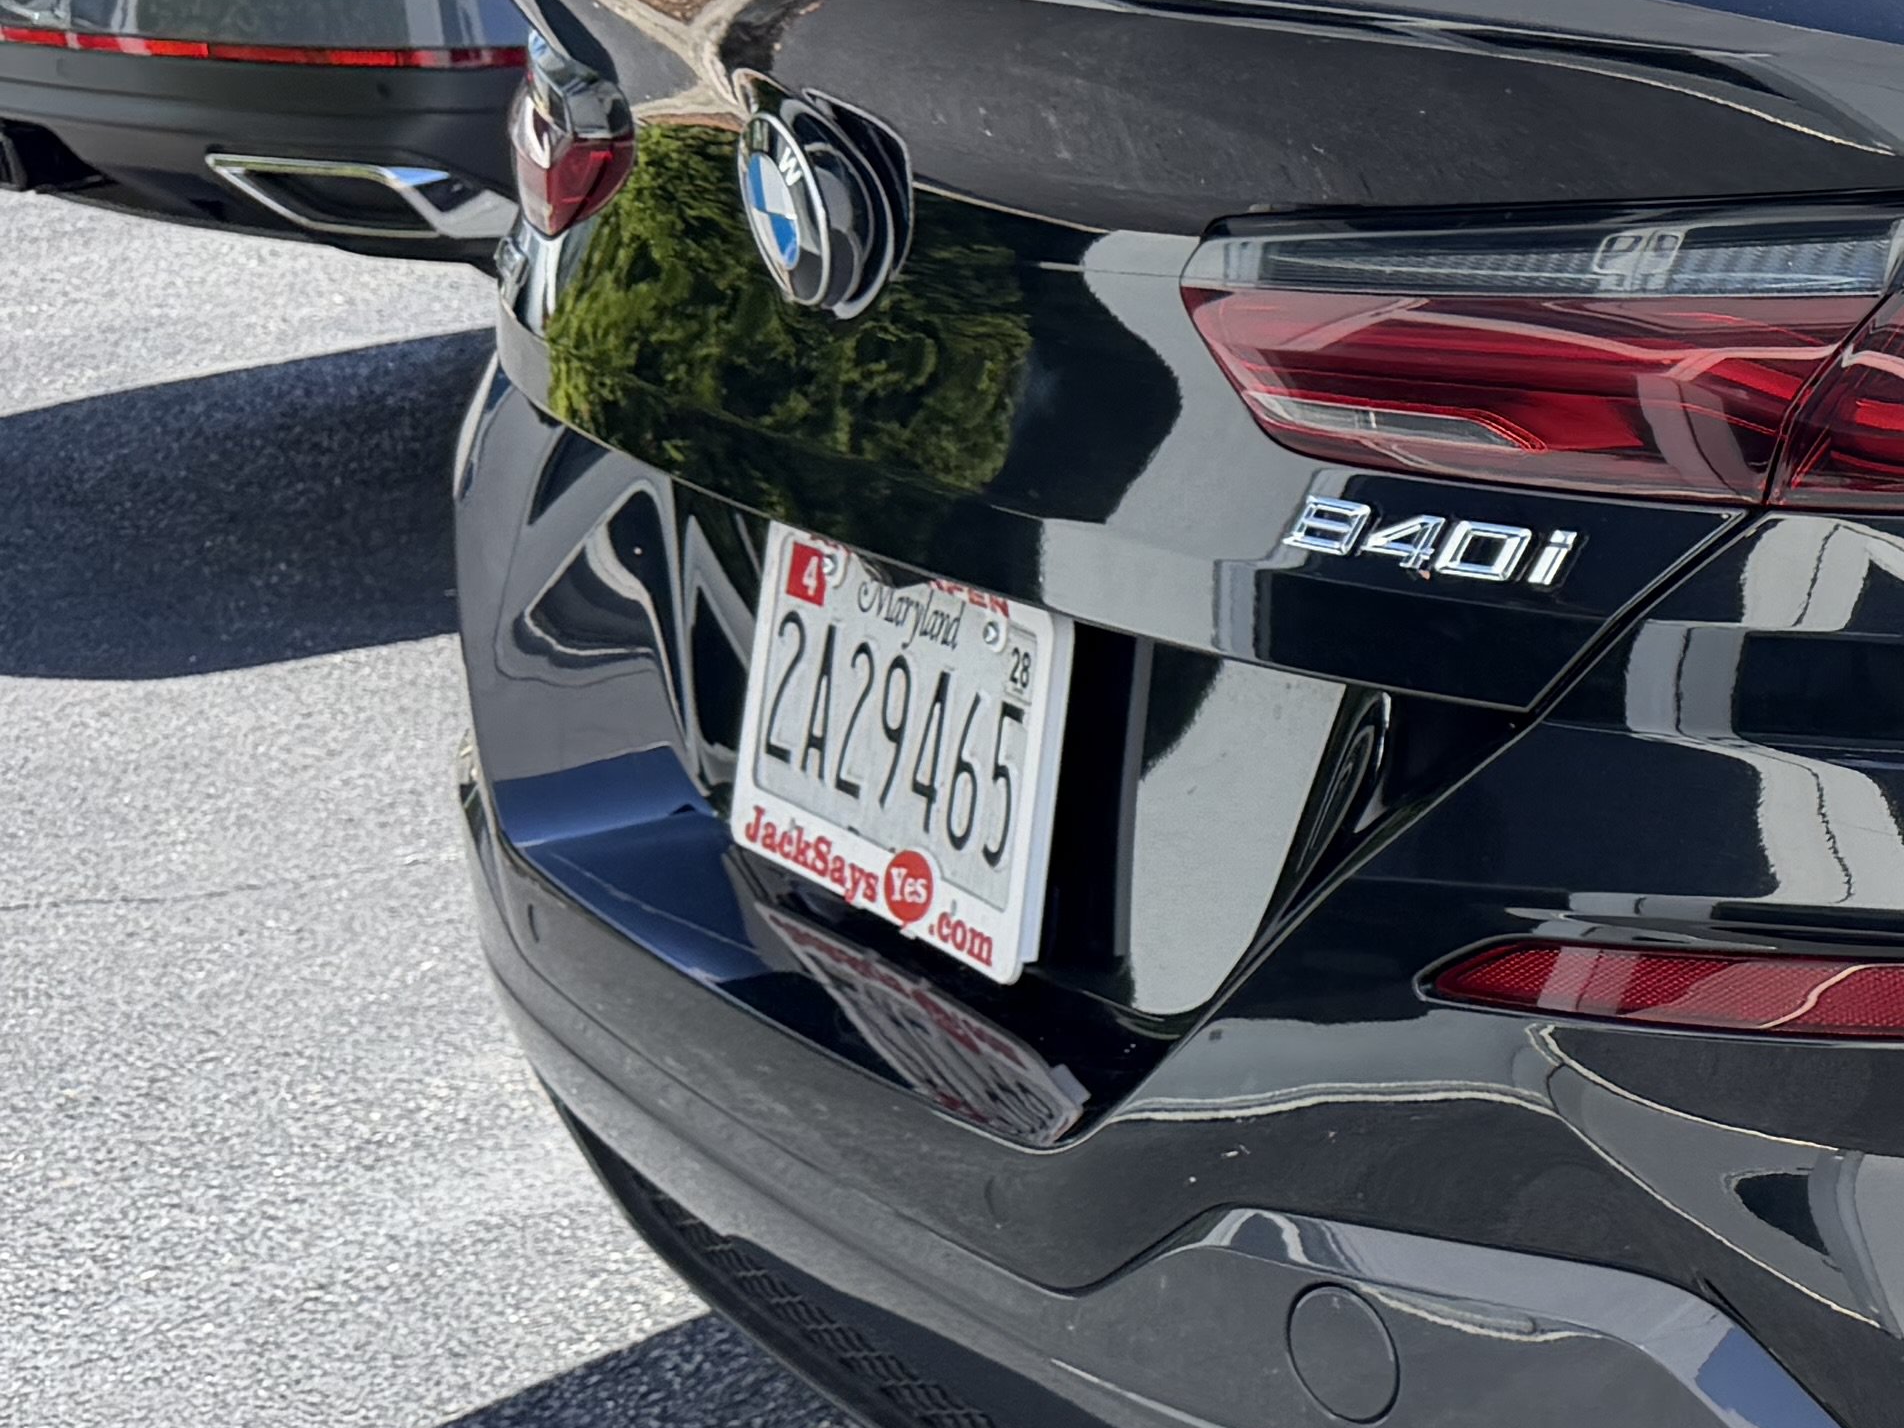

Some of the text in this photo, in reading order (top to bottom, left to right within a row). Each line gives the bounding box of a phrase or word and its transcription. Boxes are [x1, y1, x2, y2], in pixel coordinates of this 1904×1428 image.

[802, 555, 818, 596] 4
[857, 579, 966, 650] Maryland
[1010, 647, 1031, 688] 28
[765, 610, 1024, 868] 2A29465
